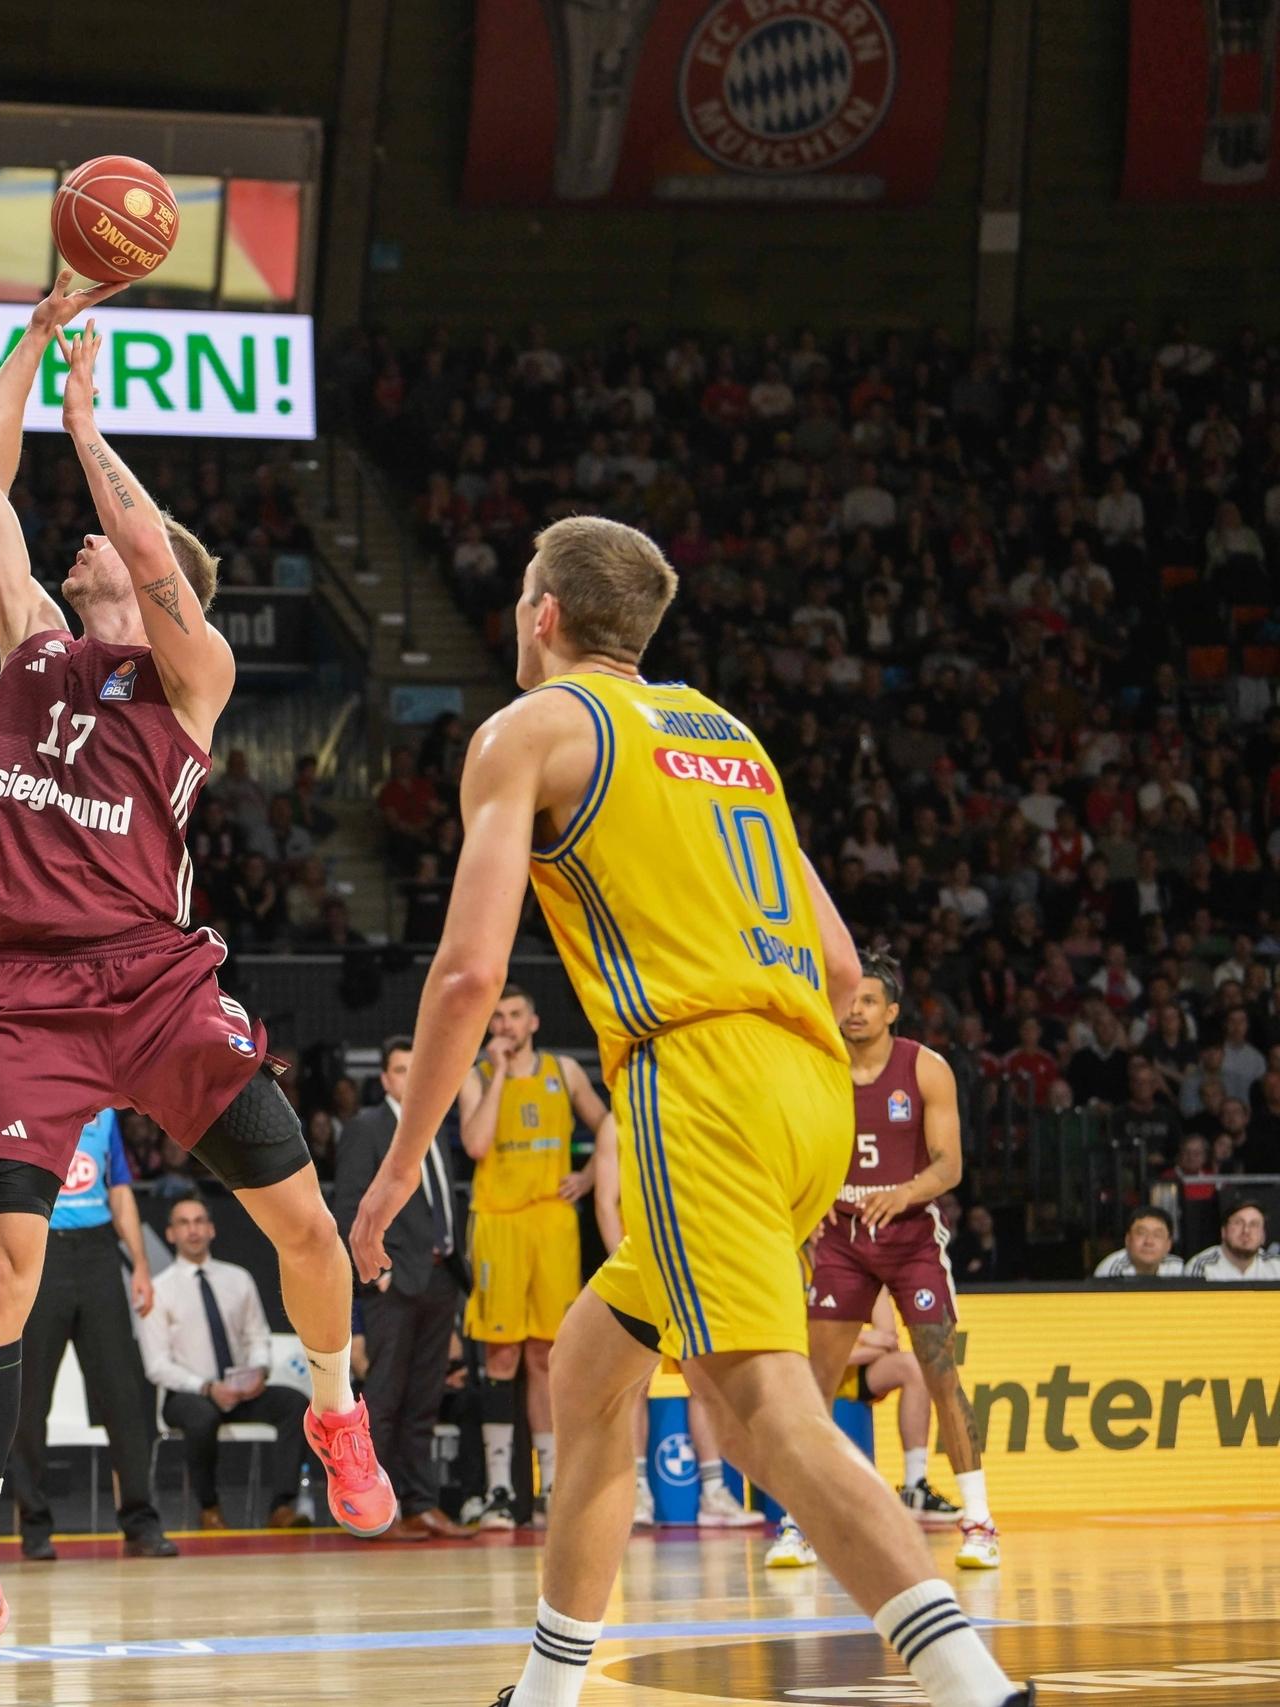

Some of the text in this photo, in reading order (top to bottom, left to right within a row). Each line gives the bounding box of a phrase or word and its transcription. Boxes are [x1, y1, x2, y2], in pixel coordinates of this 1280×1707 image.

[103, 686, 128, 696] BBL
[36, 700, 97, 765] 17
[710, 799, 791, 924] 10
[856, 1133, 879, 1168] 5
